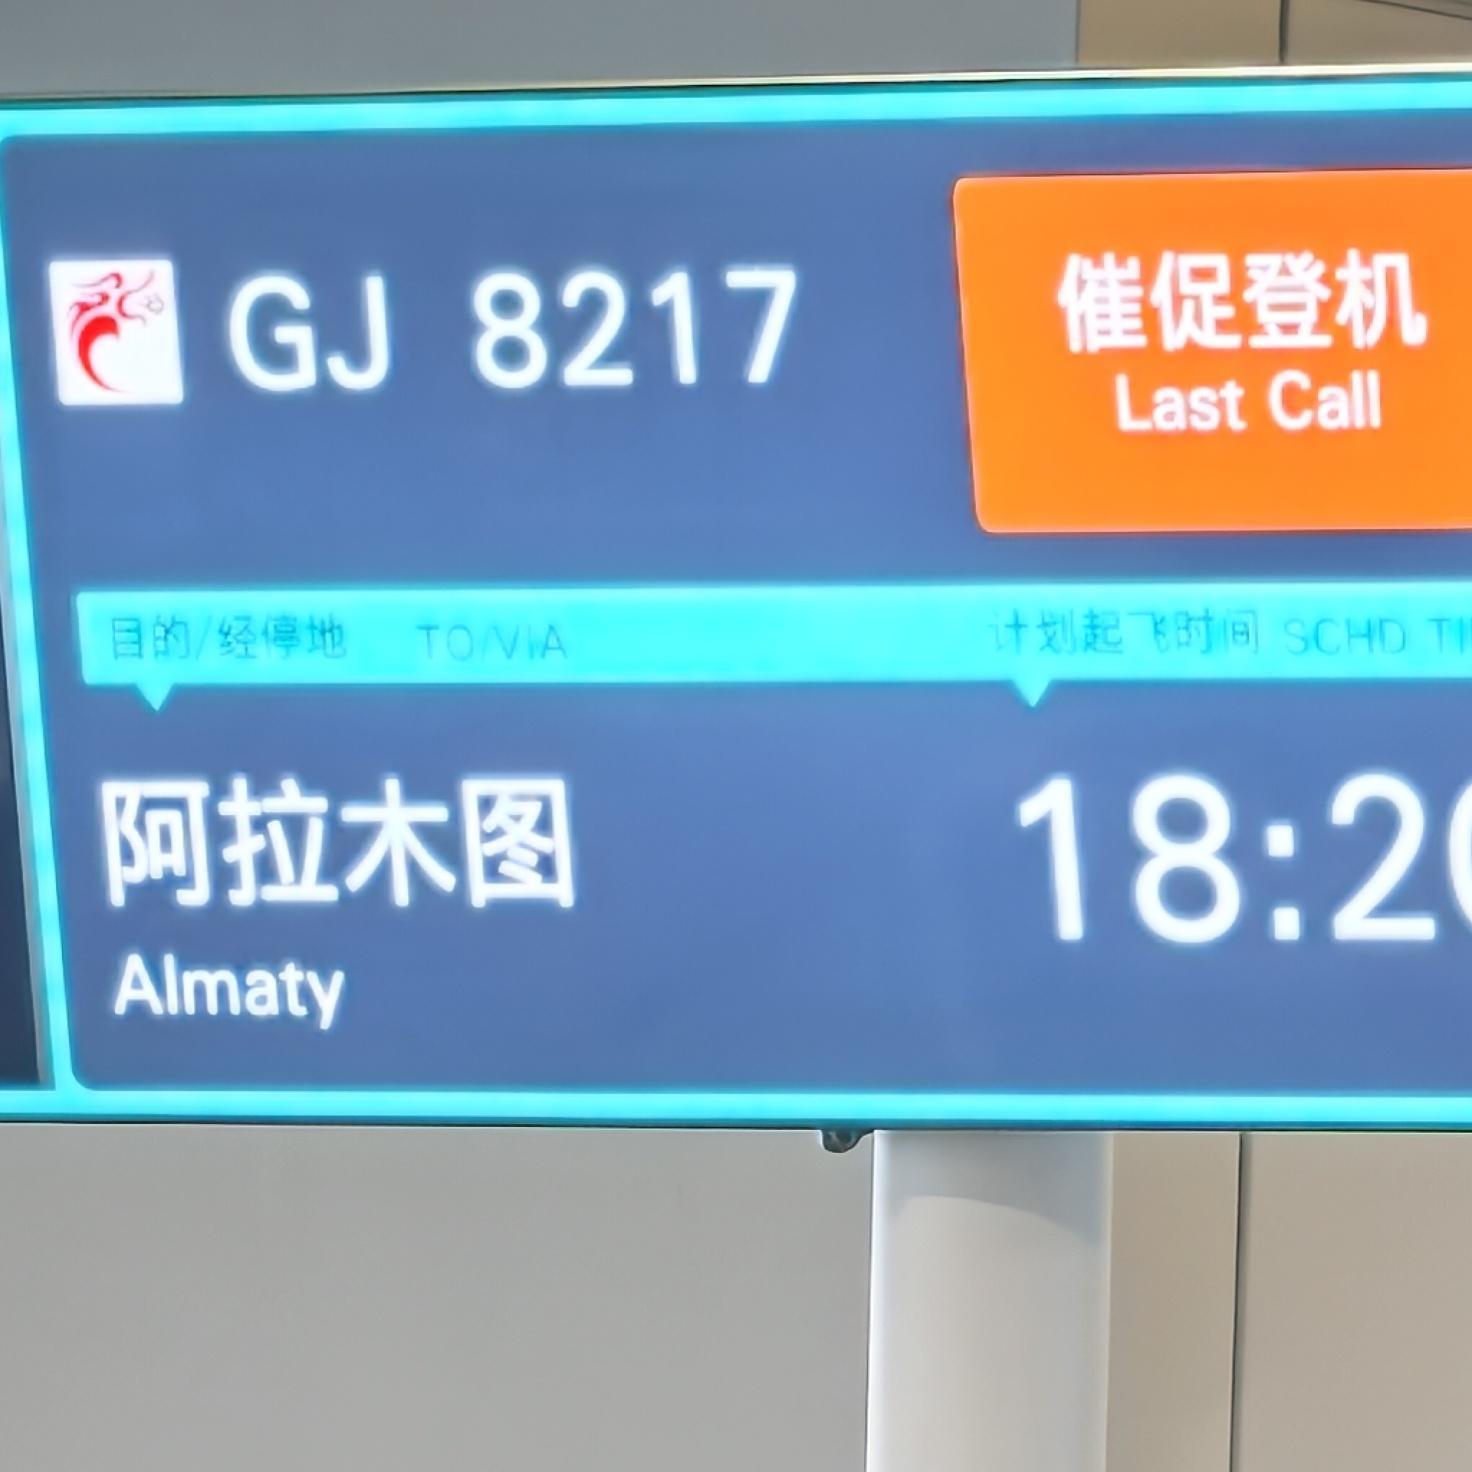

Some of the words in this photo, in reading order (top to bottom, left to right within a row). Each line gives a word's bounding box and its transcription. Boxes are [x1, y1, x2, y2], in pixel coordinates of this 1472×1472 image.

[227, 274, 393, 391] GJ
[472, 266, 798, 390] 8217
[1055, 250, 1428, 353] 催促登机
[1114, 373, 1245, 432] Last
[1269, 370, 1383, 429] Call
[112, 615, 347, 660] 目的/经停地
[417, 624, 567, 661] TO/VIA
[992, 607, 1260, 655] 计划起飞时间
[1284, 617, 1408, 655] SCHD
[101, 776, 576, 909] 阿拉木图
[113, 953, 345, 1031] Almaty
